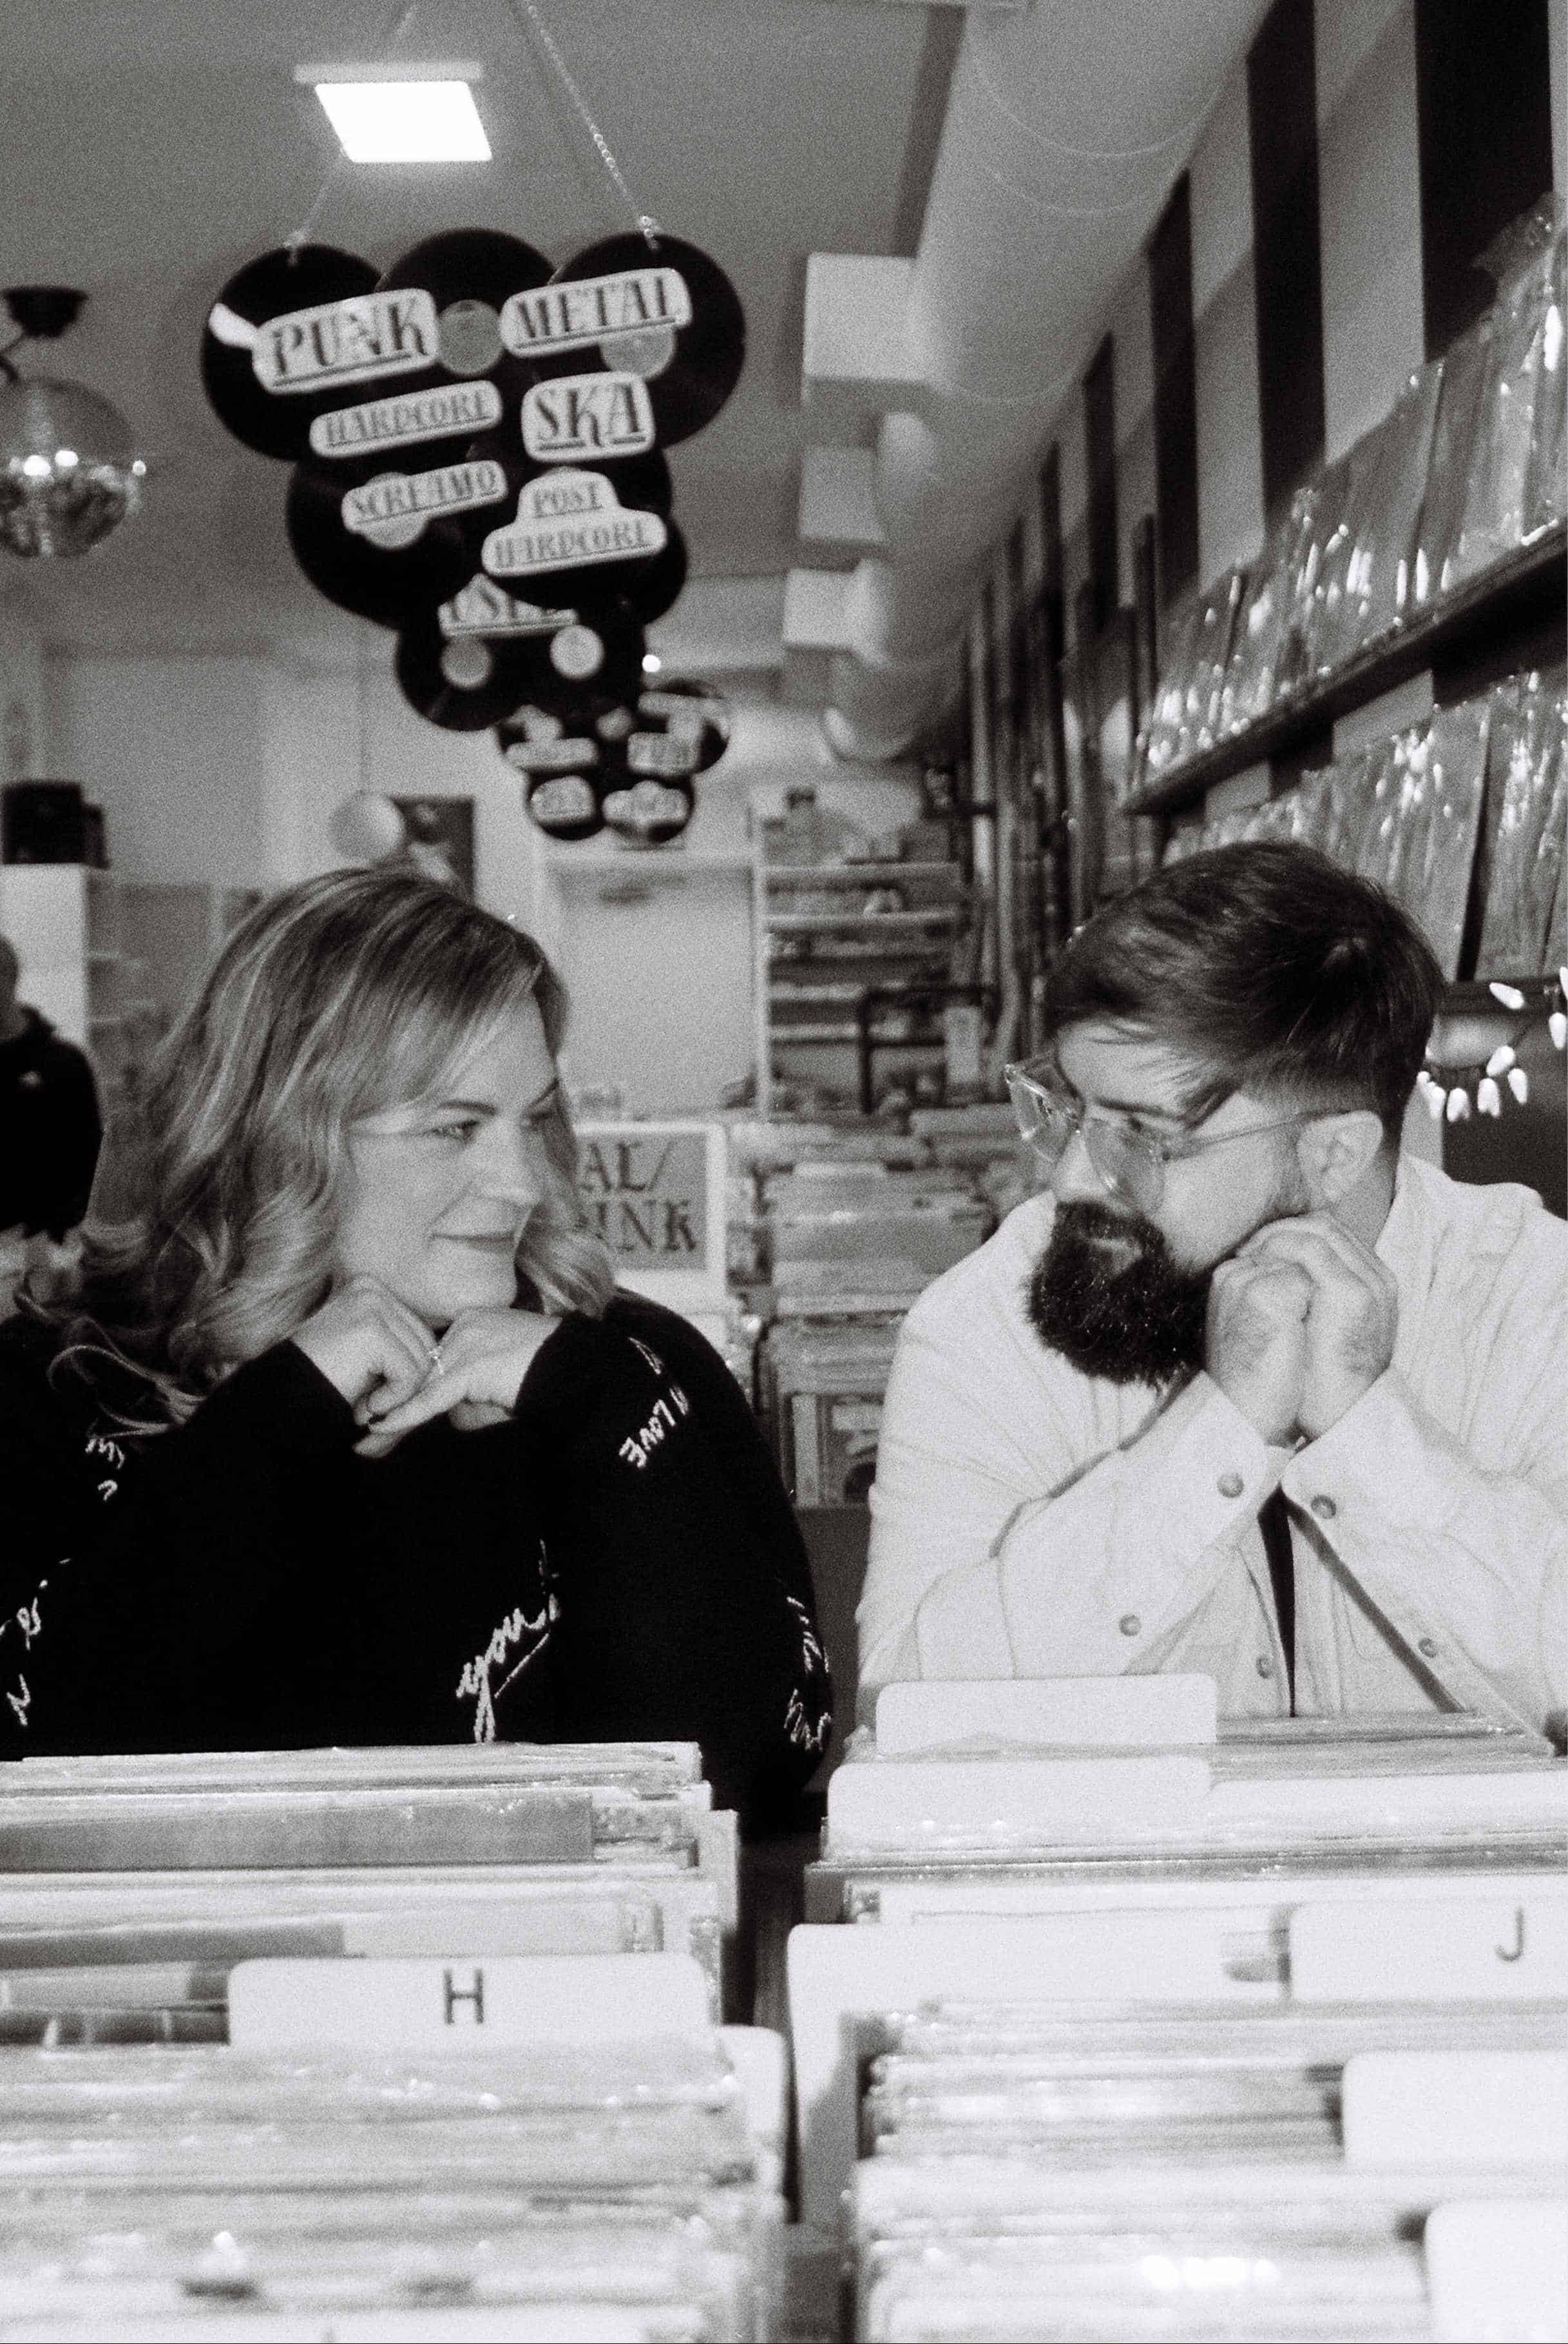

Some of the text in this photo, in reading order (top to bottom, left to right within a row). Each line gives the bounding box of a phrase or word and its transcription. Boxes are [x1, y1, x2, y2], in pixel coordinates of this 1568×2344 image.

[515, 274, 676, 340] METAL
[271, 296, 428, 376] PUNK
[325, 389, 490, 445] HARDCORE
[533, 382, 645, 447] SKA
[354, 465, 499, 519] SCREAMO
[531, 481, 602, 516] POST
[492, 519, 653, 568] HARDCORE
[1494, 1906, 1525, 1961] J
[445, 1968, 484, 2026] H
